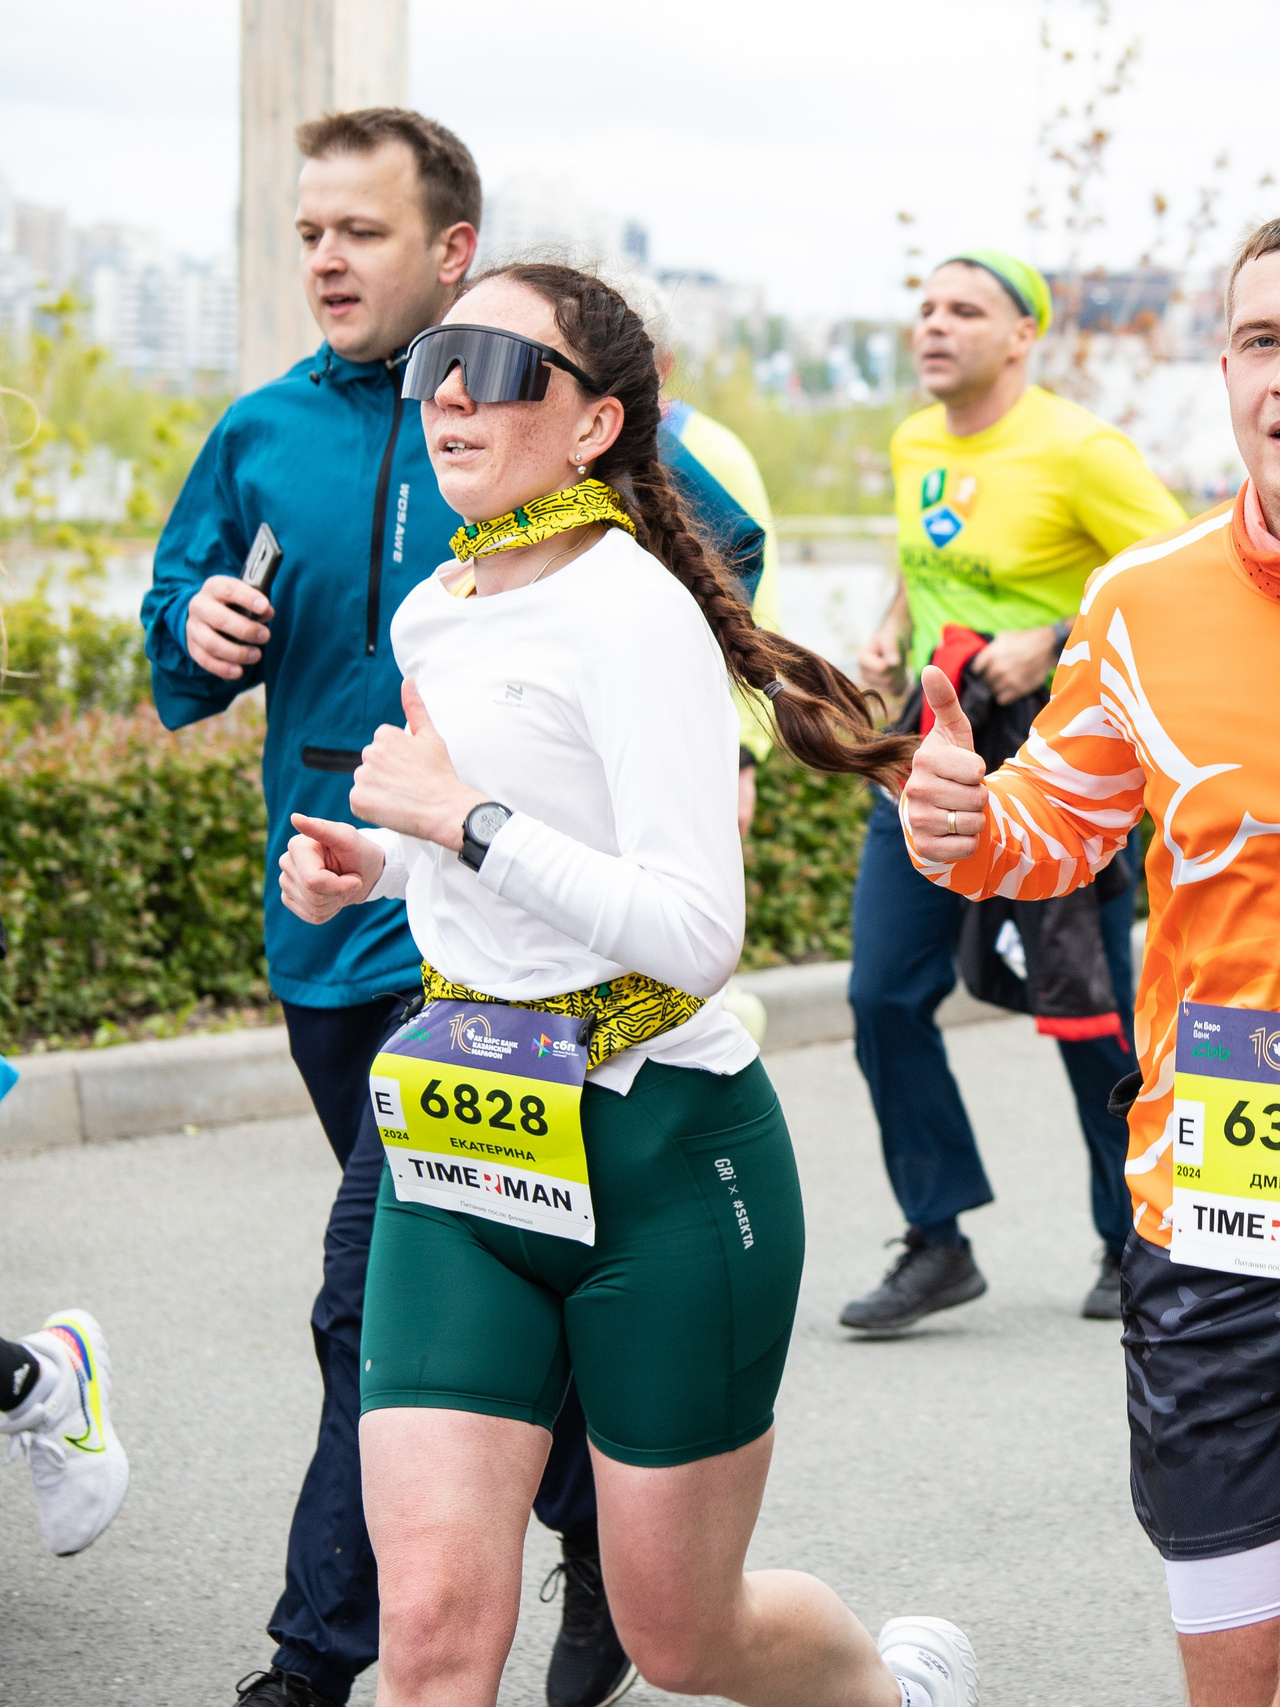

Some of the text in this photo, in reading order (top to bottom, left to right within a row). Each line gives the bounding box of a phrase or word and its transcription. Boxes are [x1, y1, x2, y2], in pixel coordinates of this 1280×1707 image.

[374, 1091, 394, 1115] E
[420, 1078, 549, 1136] 6828
[383, 1128, 409, 1141] 2024
[1179, 1117, 1195, 1146] E
[449, 1137, 536, 1162] ЕКАТЕРИНА
[1176, 1165, 1201, 1180] 2024
[732, 1199, 755, 1250] #SEKTA
[1234, 1258, 1267, 1269] Питание
